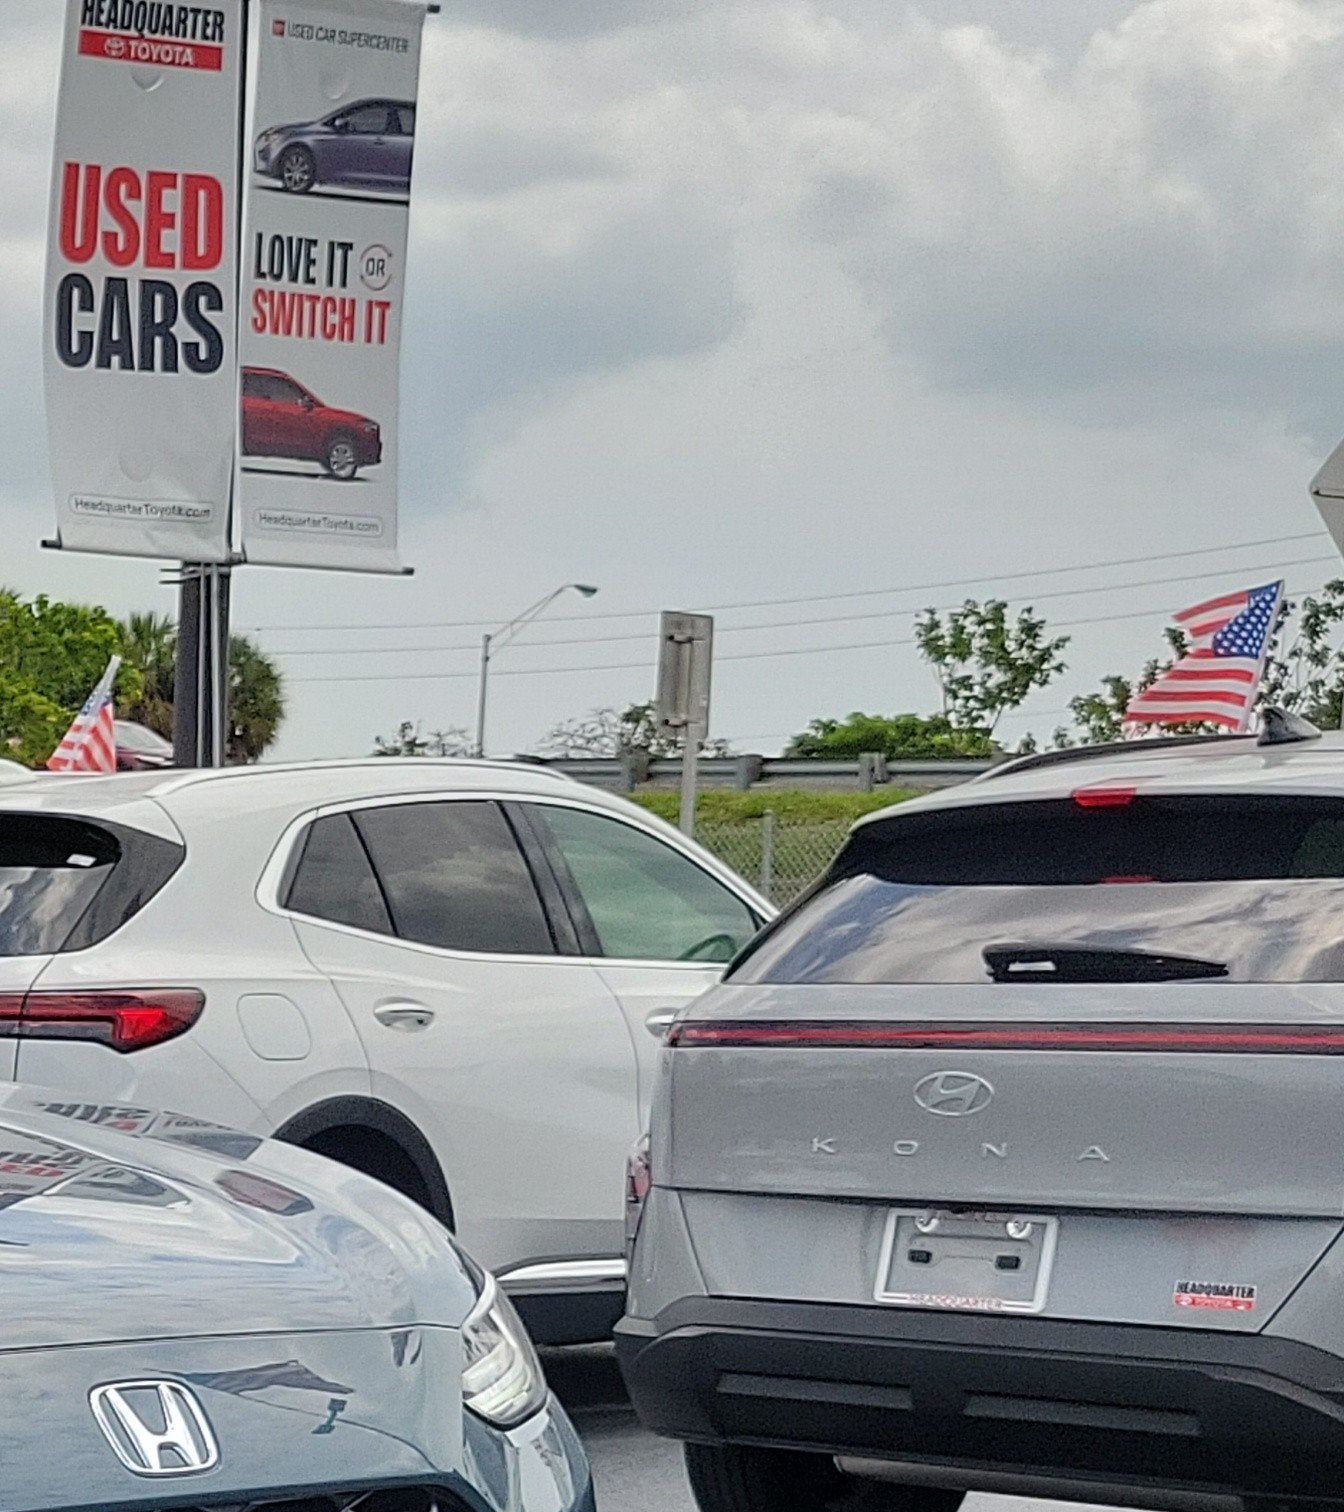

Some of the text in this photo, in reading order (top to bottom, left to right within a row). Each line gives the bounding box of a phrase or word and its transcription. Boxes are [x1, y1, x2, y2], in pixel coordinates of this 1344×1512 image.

[81, 0, 225, 42] HEADQUARTER
[287, 22, 314, 40] USED
[316, 27, 336, 44] CAR
[129, 40, 195, 65] TOYOTA
[59, 162, 224, 271] USED
[255, 232, 386, 288] LOVE IT OR
[56, 272, 224, 374] CARS
[251, 287, 391, 344] SWITCH IT
[812, 1138, 1110, 1162] KONA
[1176, 1281, 1255, 1299] HEADQUARTER
